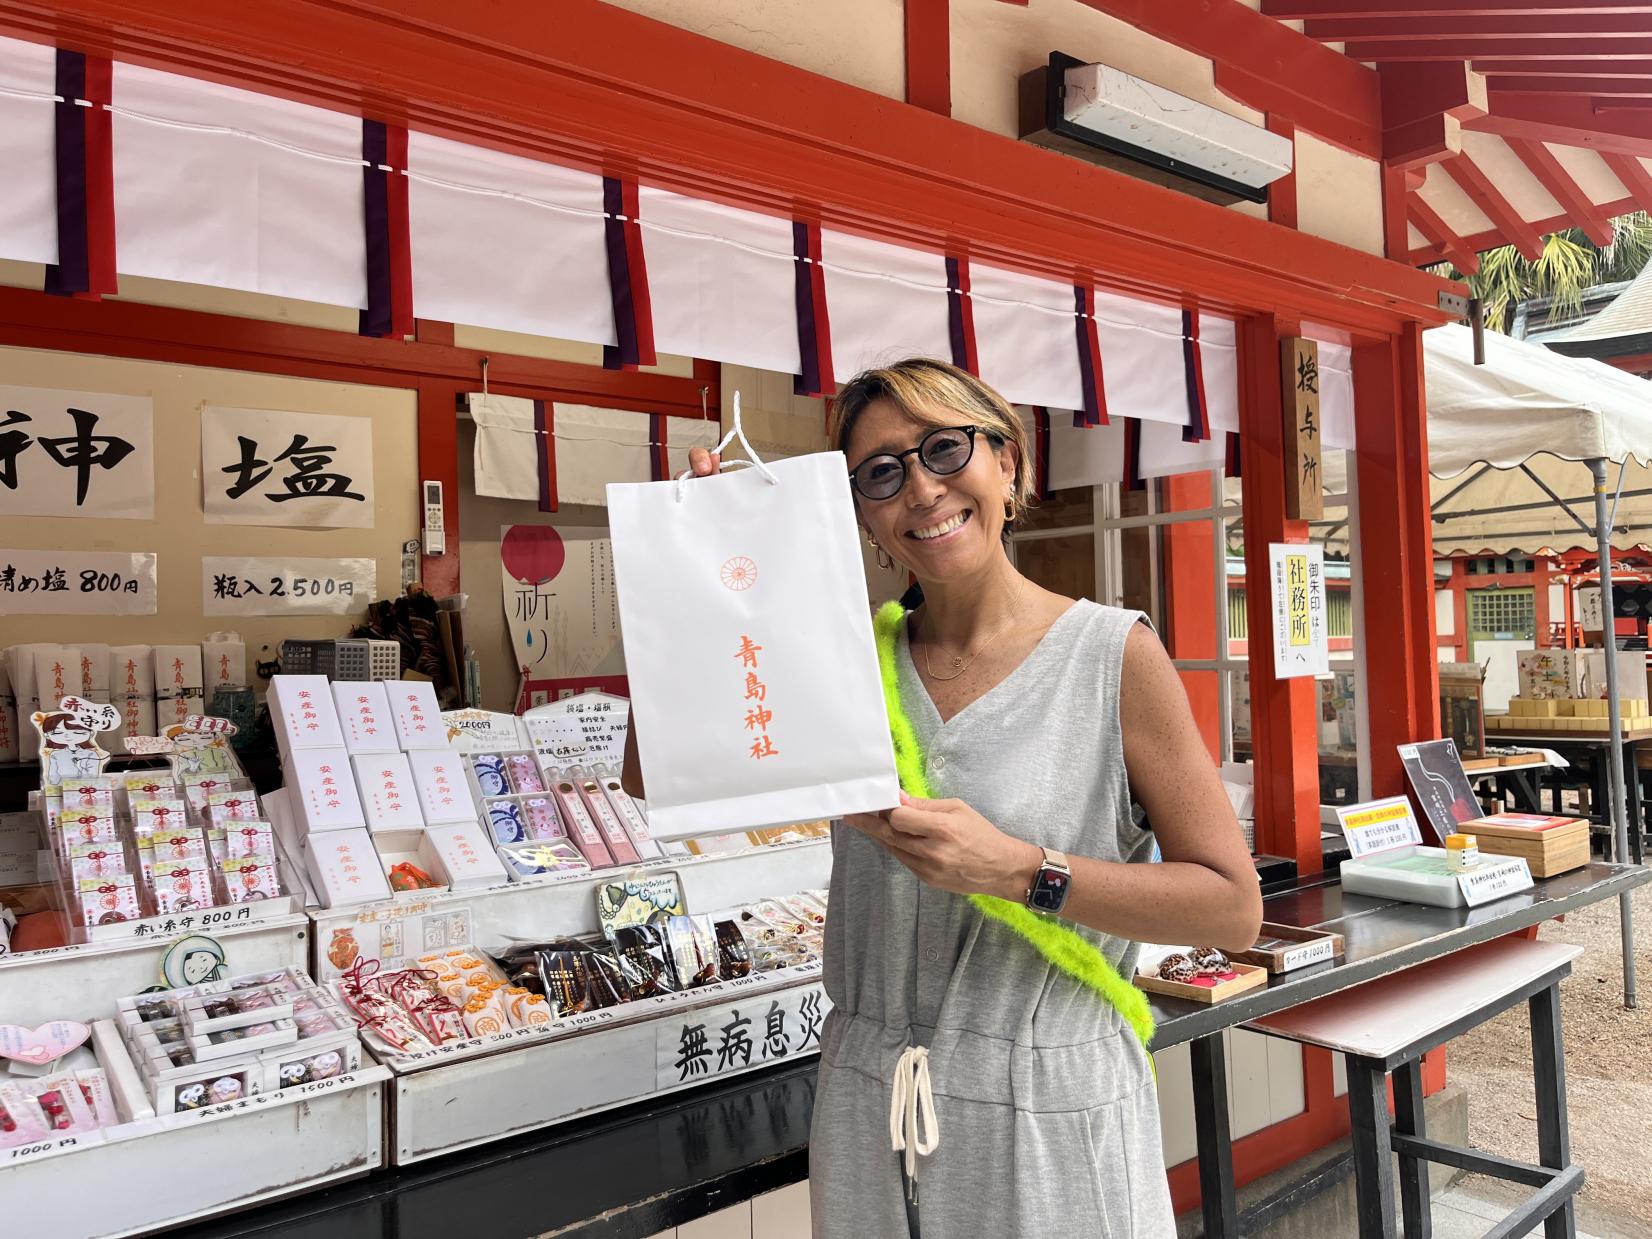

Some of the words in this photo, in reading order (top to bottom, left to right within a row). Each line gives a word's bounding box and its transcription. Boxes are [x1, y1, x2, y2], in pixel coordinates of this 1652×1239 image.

[1297, 352, 1318, 494] 授与所
[221, 434, 366, 503] 塩
[79, 570, 139, 594] 800円
[514, 582, 557, 663] 祈り
[733, 635, 780, 761] 青島神社
[134, 917, 194, 936] 赤い糸守
[674, 989, 822, 1082] 無病息災
[12, 1143, 53, 1158] 1000
